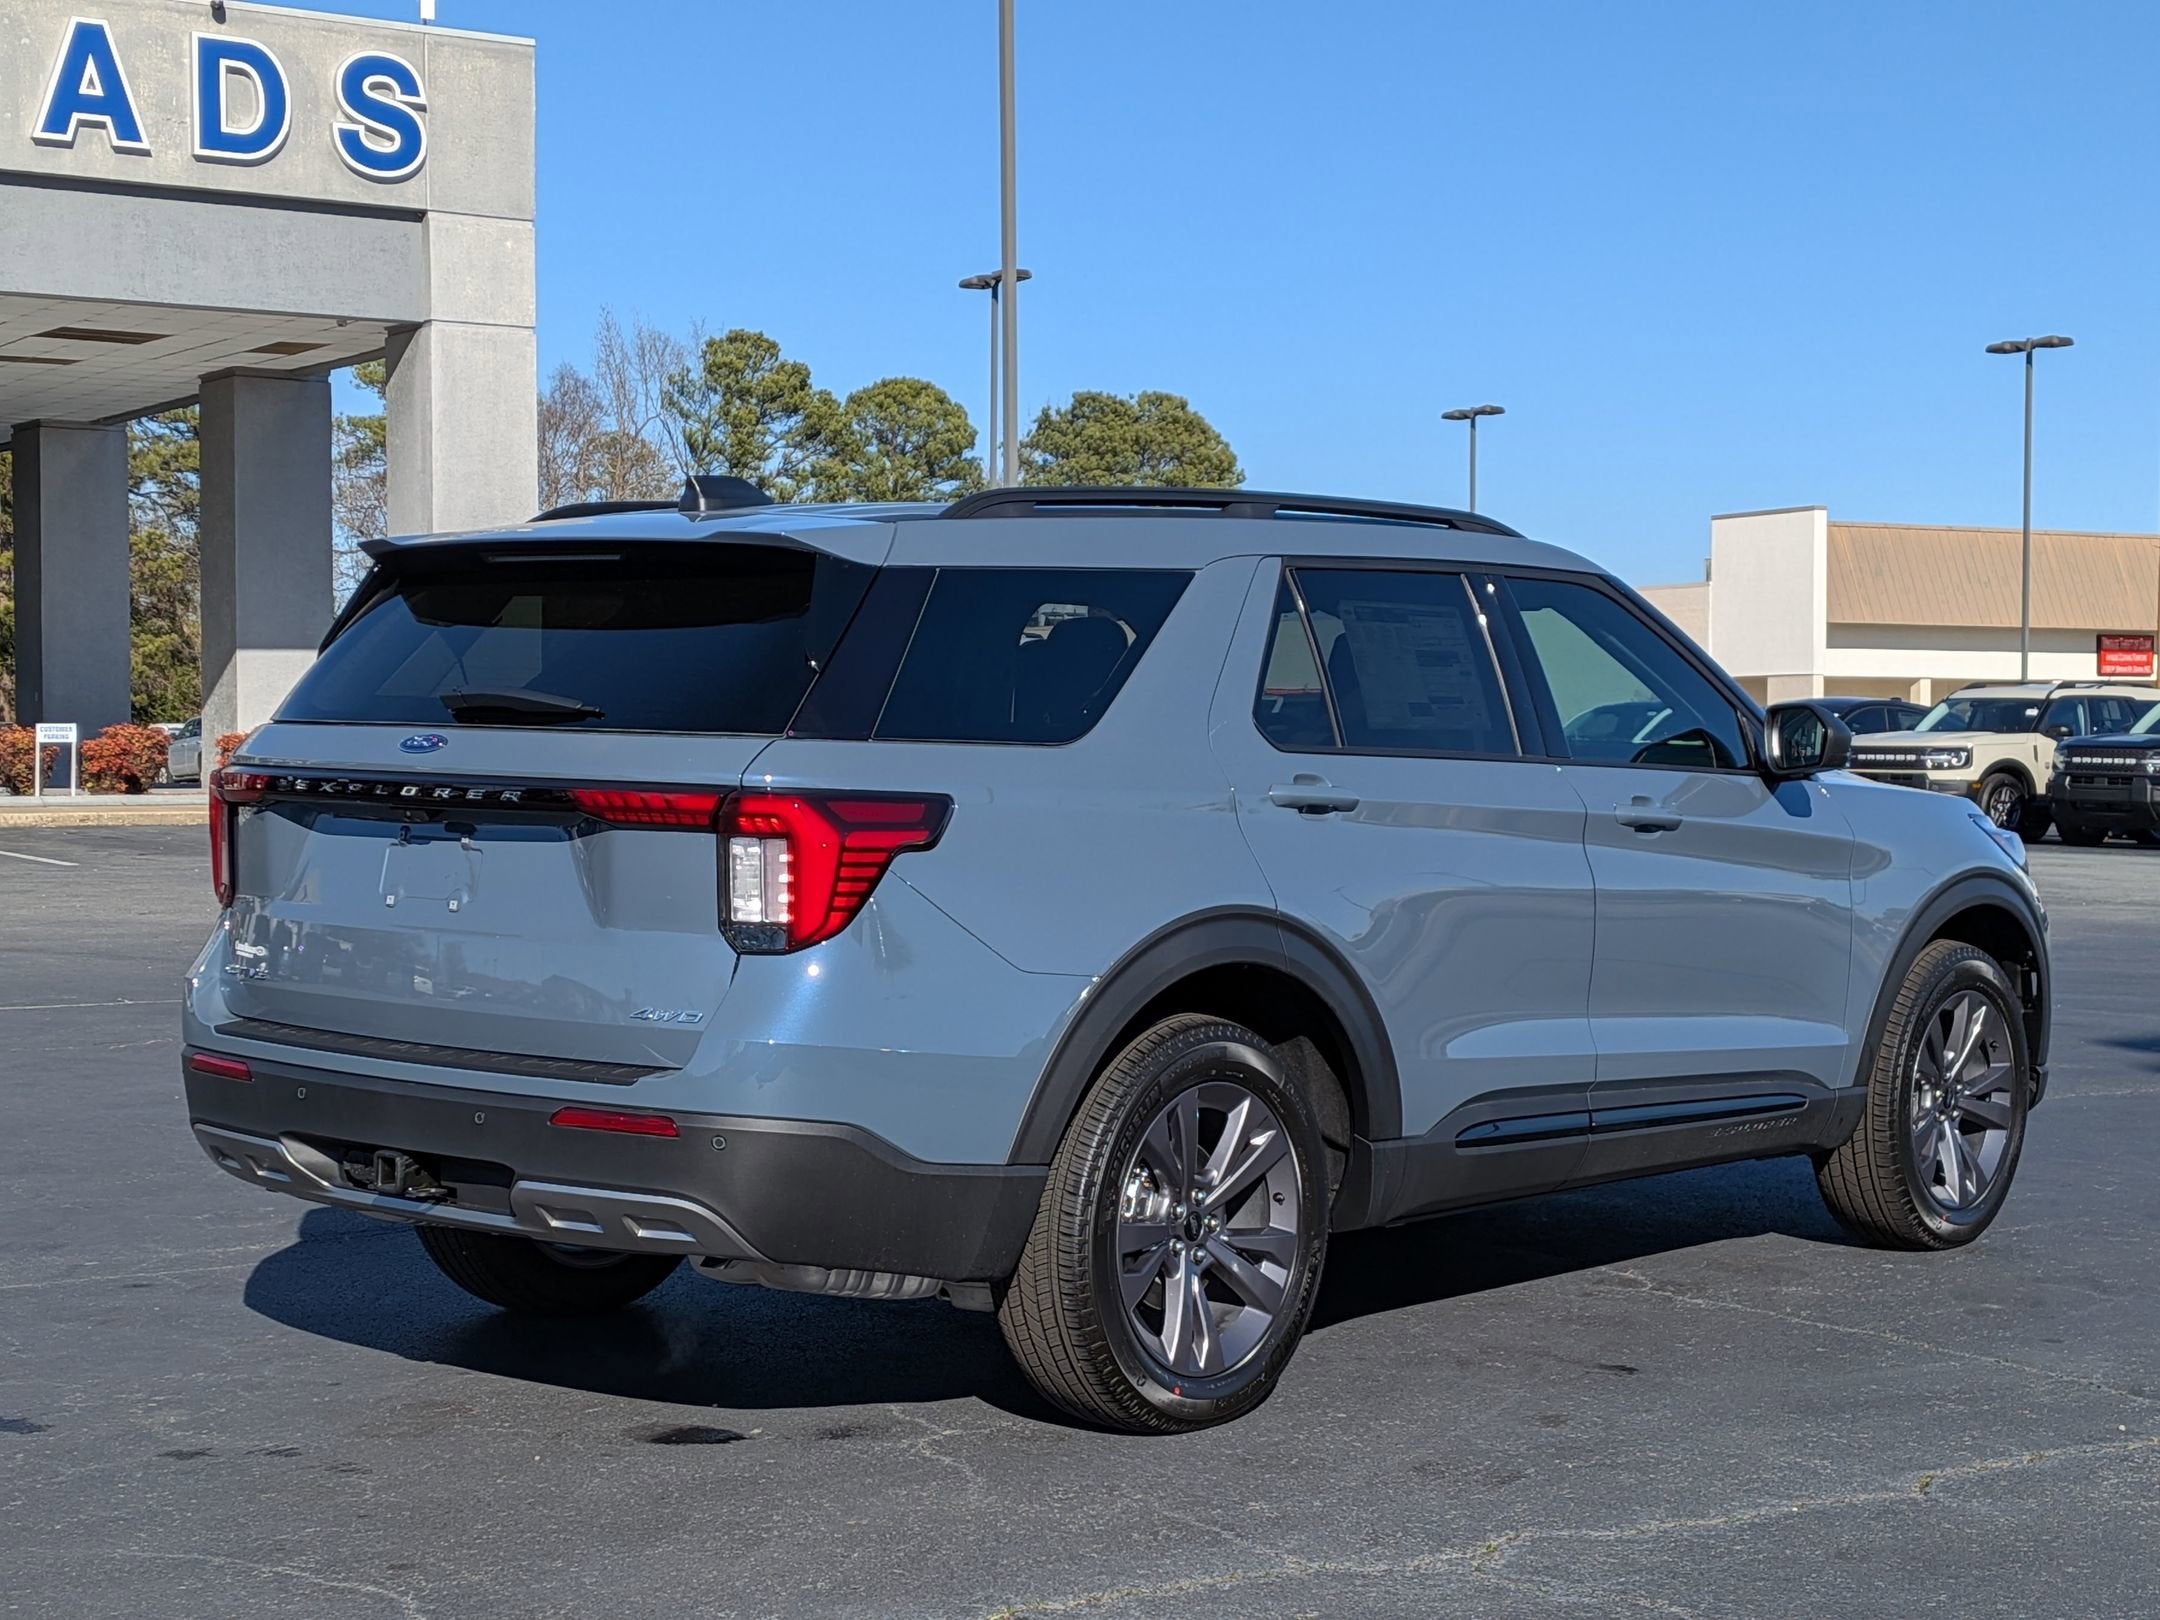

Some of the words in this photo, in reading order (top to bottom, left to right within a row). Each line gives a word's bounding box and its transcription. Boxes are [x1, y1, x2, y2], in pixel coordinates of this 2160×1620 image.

[32, 16, 428, 183] ADS
[295, 778, 522, 802] EXPLORER
[629, 1008, 704, 1023] 4WD
